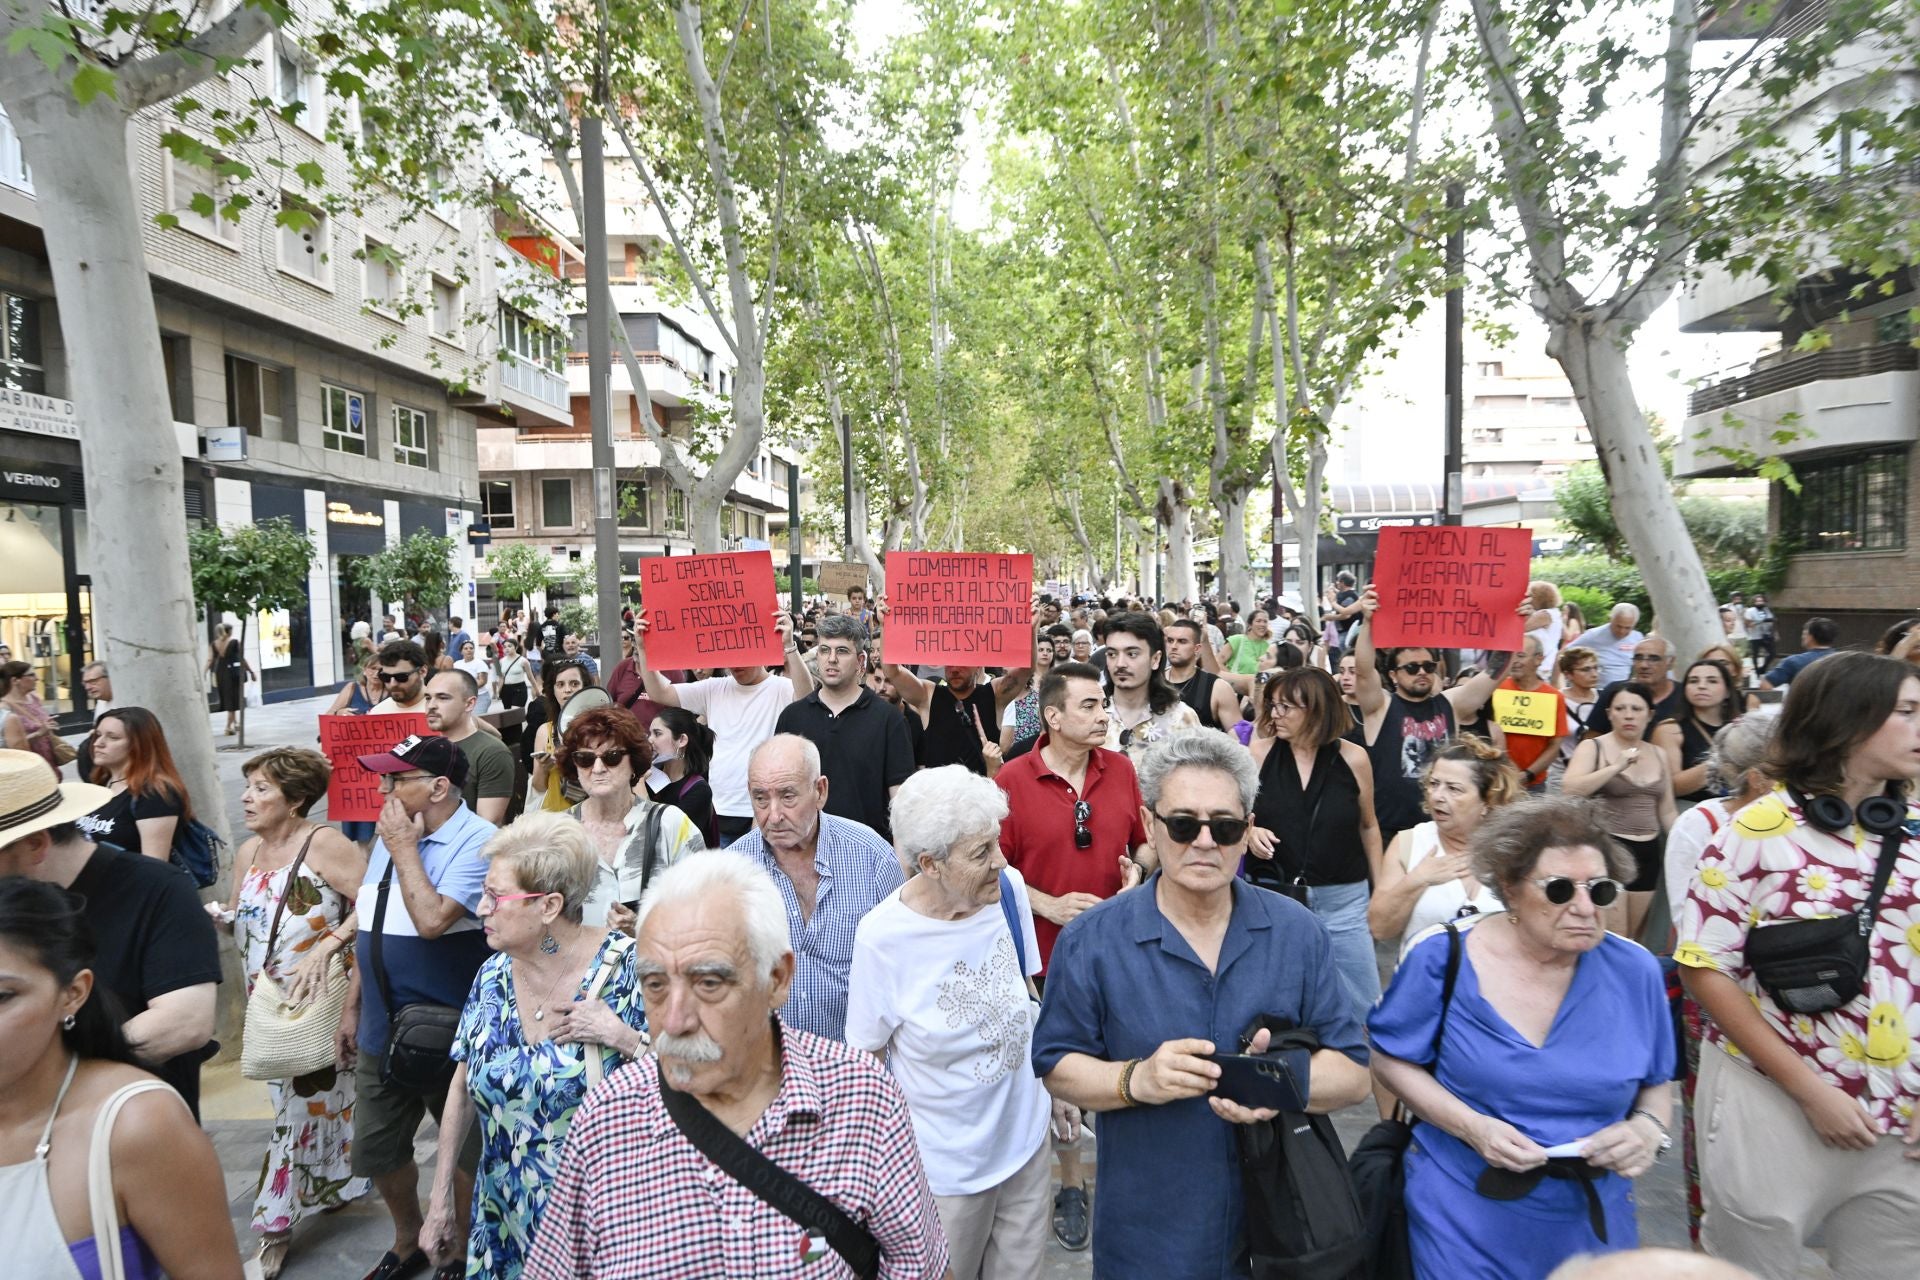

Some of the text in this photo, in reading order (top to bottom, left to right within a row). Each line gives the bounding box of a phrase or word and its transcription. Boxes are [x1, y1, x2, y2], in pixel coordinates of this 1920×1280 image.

[3, 471, 60, 488] VERINO
[1400, 531, 1507, 557] TEMEN AL
[651, 557, 745, 584] EL CAPITAL
[908, 557, 1018, 580] COMBATIR AL
[1398, 561, 1506, 588] MIGRANTE
[688, 580, 745, 602] SEÑALA
[896, 581, 1028, 603] IMPERIALISMO
[1396, 588, 1478, 608] AMAN AL
[655, 602, 758, 632] EL FASCISMO
[893, 606, 1031, 625] PARA ACABAR CON EL
[1401, 607, 1497, 638] PATRÓN
[695, 626, 767, 653] EJECUTA
[915, 629, 1003, 653] RACISMO
[1512, 695, 1532, 707] NO
[329, 718, 417, 741] GOBIERNO
[342, 787, 381, 809] RAC
